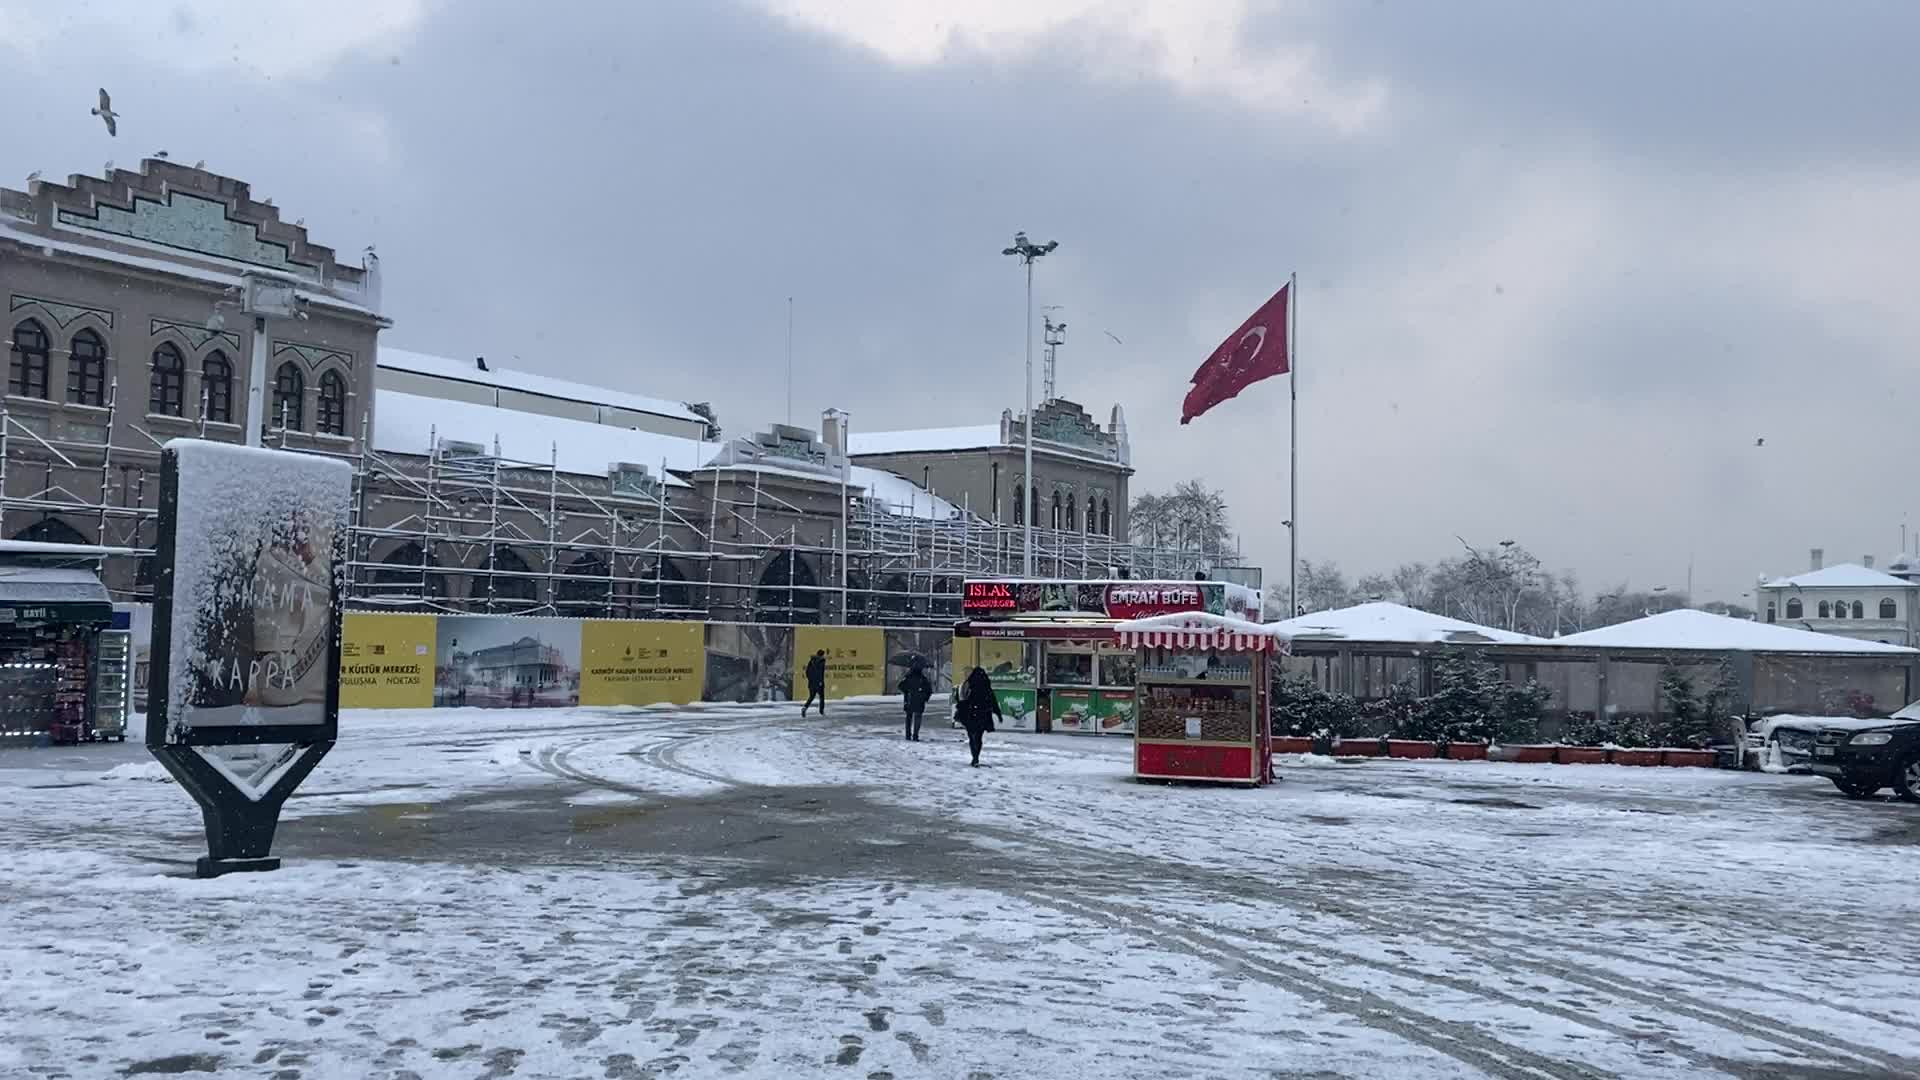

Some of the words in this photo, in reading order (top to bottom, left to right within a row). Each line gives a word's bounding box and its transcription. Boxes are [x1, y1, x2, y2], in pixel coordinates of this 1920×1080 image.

[969, 584, 1010, 597] ISLAK
[964, 599, 1016, 608] HAMBURGER
[1110, 590, 1159, 605] EMRAH
[210, 657, 296, 691] KAPPA
[348, 663, 380, 674] KÜLTÜR
